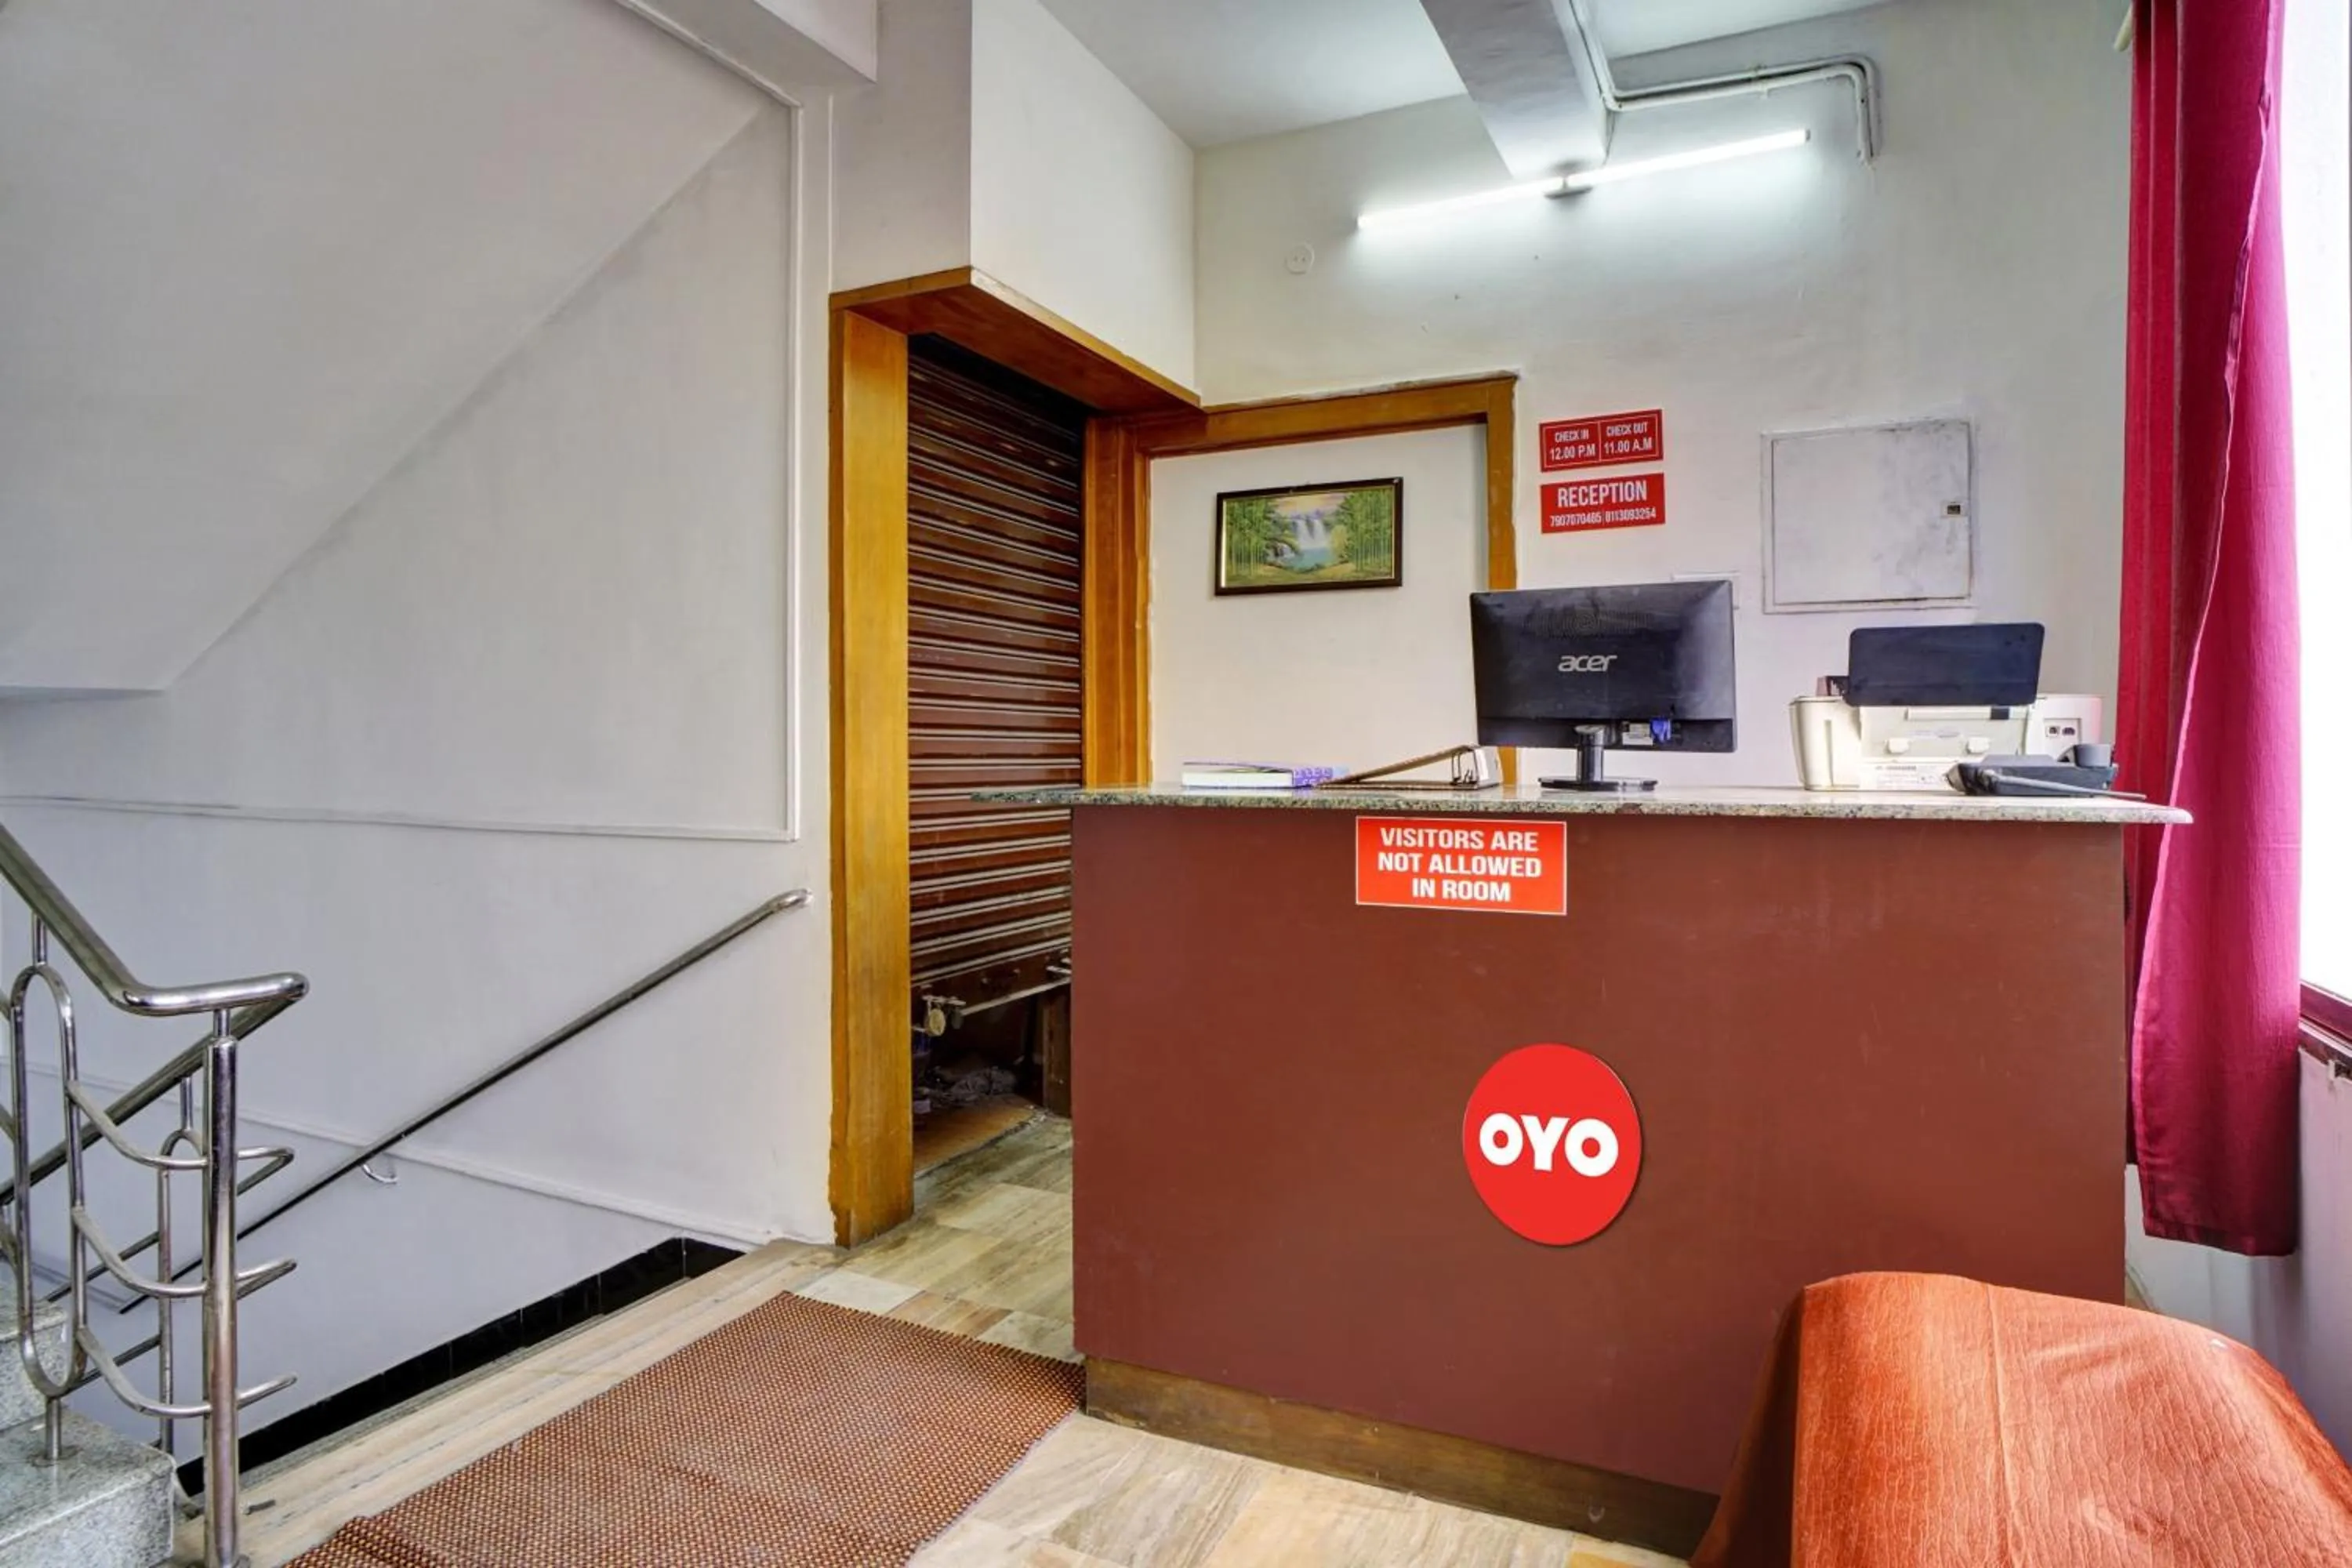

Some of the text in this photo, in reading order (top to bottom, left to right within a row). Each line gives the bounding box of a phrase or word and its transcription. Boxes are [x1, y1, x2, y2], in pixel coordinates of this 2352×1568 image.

[1555, 428, 1589, 443] CHECK IN
[1606, 421, 1648, 437] CHECK OUT
[1550, 443, 1596, 461] 12.00 P.M
[1604, 437, 1653, 455] 11.00 A.M
[1557, 479, 1647, 508] RECEPTION
[1558, 654, 1618, 672] acer
[1379, 827, 1540, 851] VISITORS ARE
[1377, 851, 1542, 877] NOT ALLOWED
[1412, 878, 1512, 902] IN ROOM
[1479, 1112, 1619, 1177] OYO
